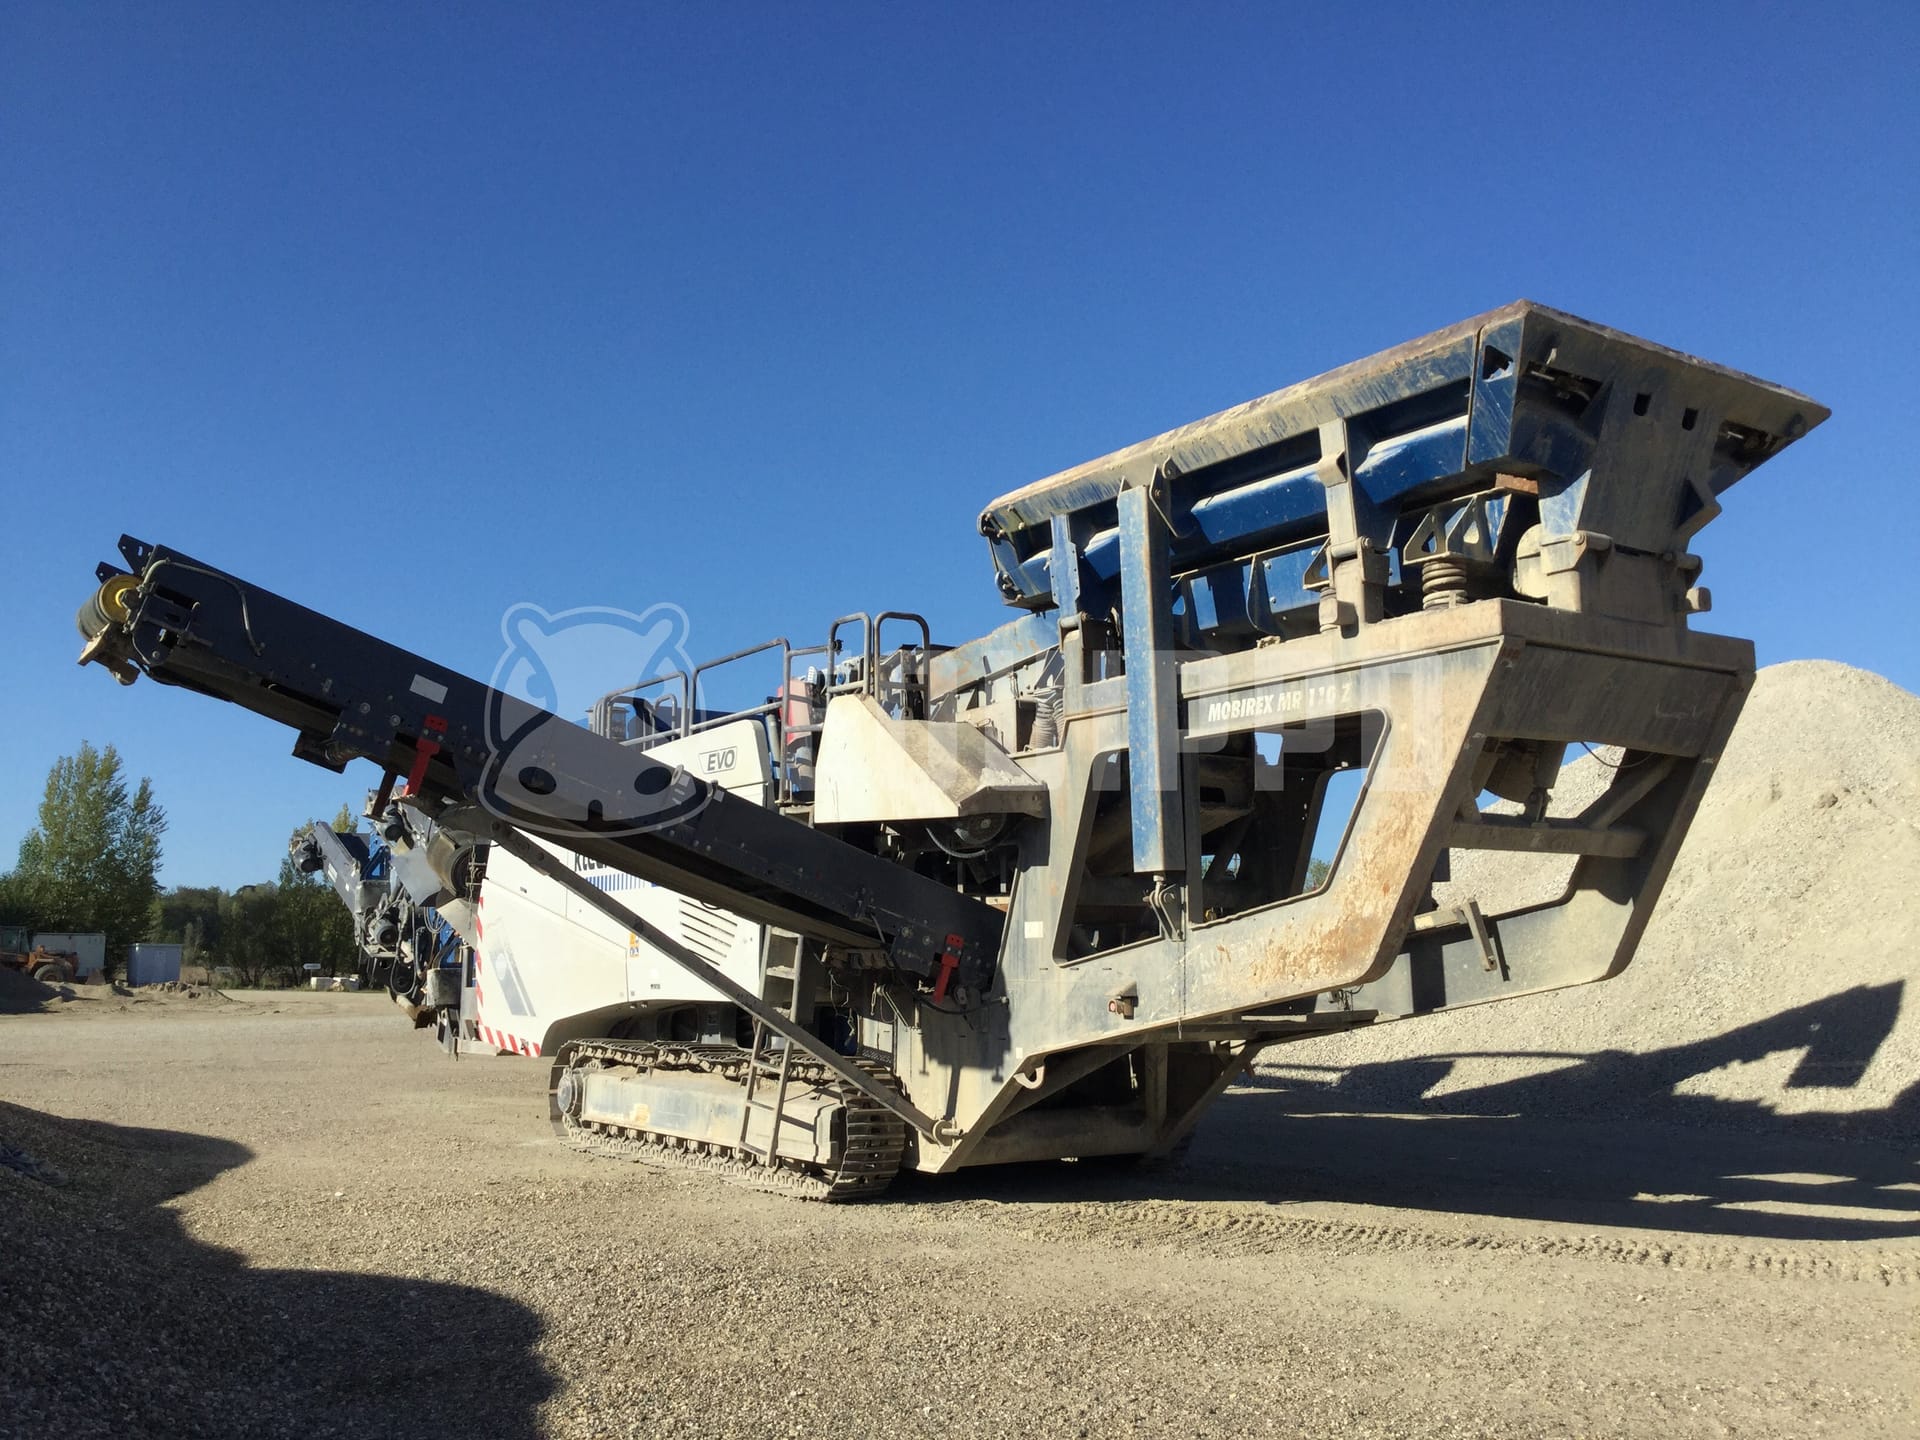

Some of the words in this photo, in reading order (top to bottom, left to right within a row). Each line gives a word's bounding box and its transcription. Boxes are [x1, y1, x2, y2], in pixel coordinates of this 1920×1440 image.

[1208, 695, 1274, 722] MOBIREX
[1277, 690, 1302, 712] MR
[707, 750, 735, 771] EVO
